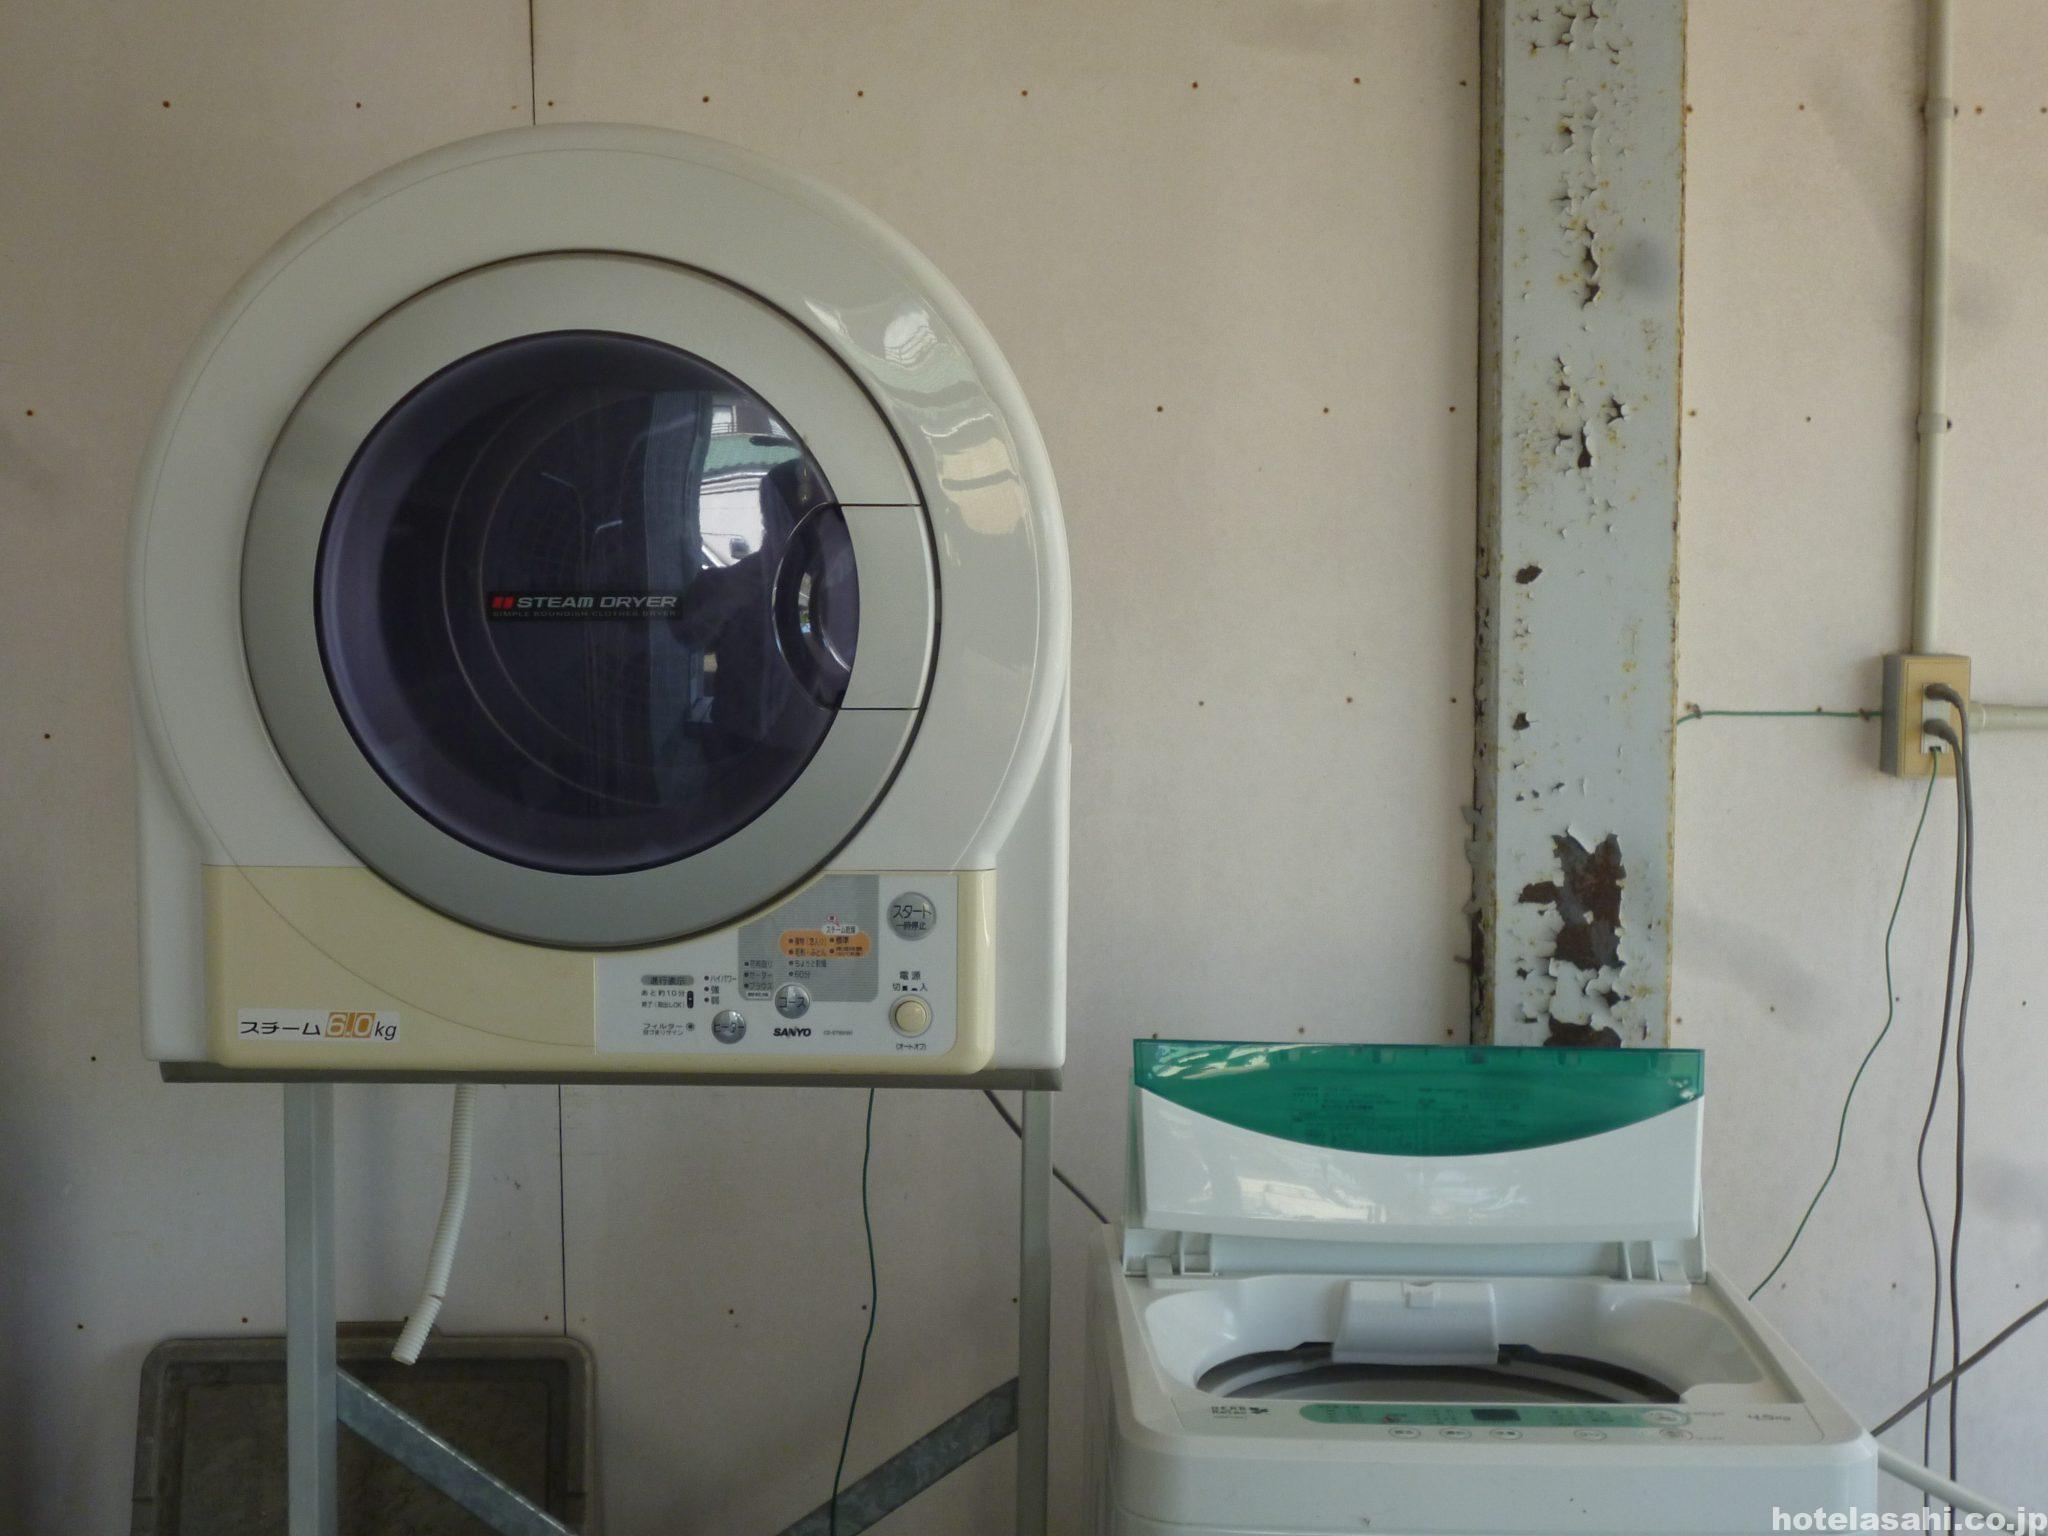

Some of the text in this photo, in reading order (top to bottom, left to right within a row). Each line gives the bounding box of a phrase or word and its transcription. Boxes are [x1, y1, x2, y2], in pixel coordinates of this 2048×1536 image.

[517, 596, 678, 609] STEAM DRYER
[893, 903, 933, 919] スタート
[779, 996, 807, 1009] コース
[773, 1027, 812, 1038] SANYO
